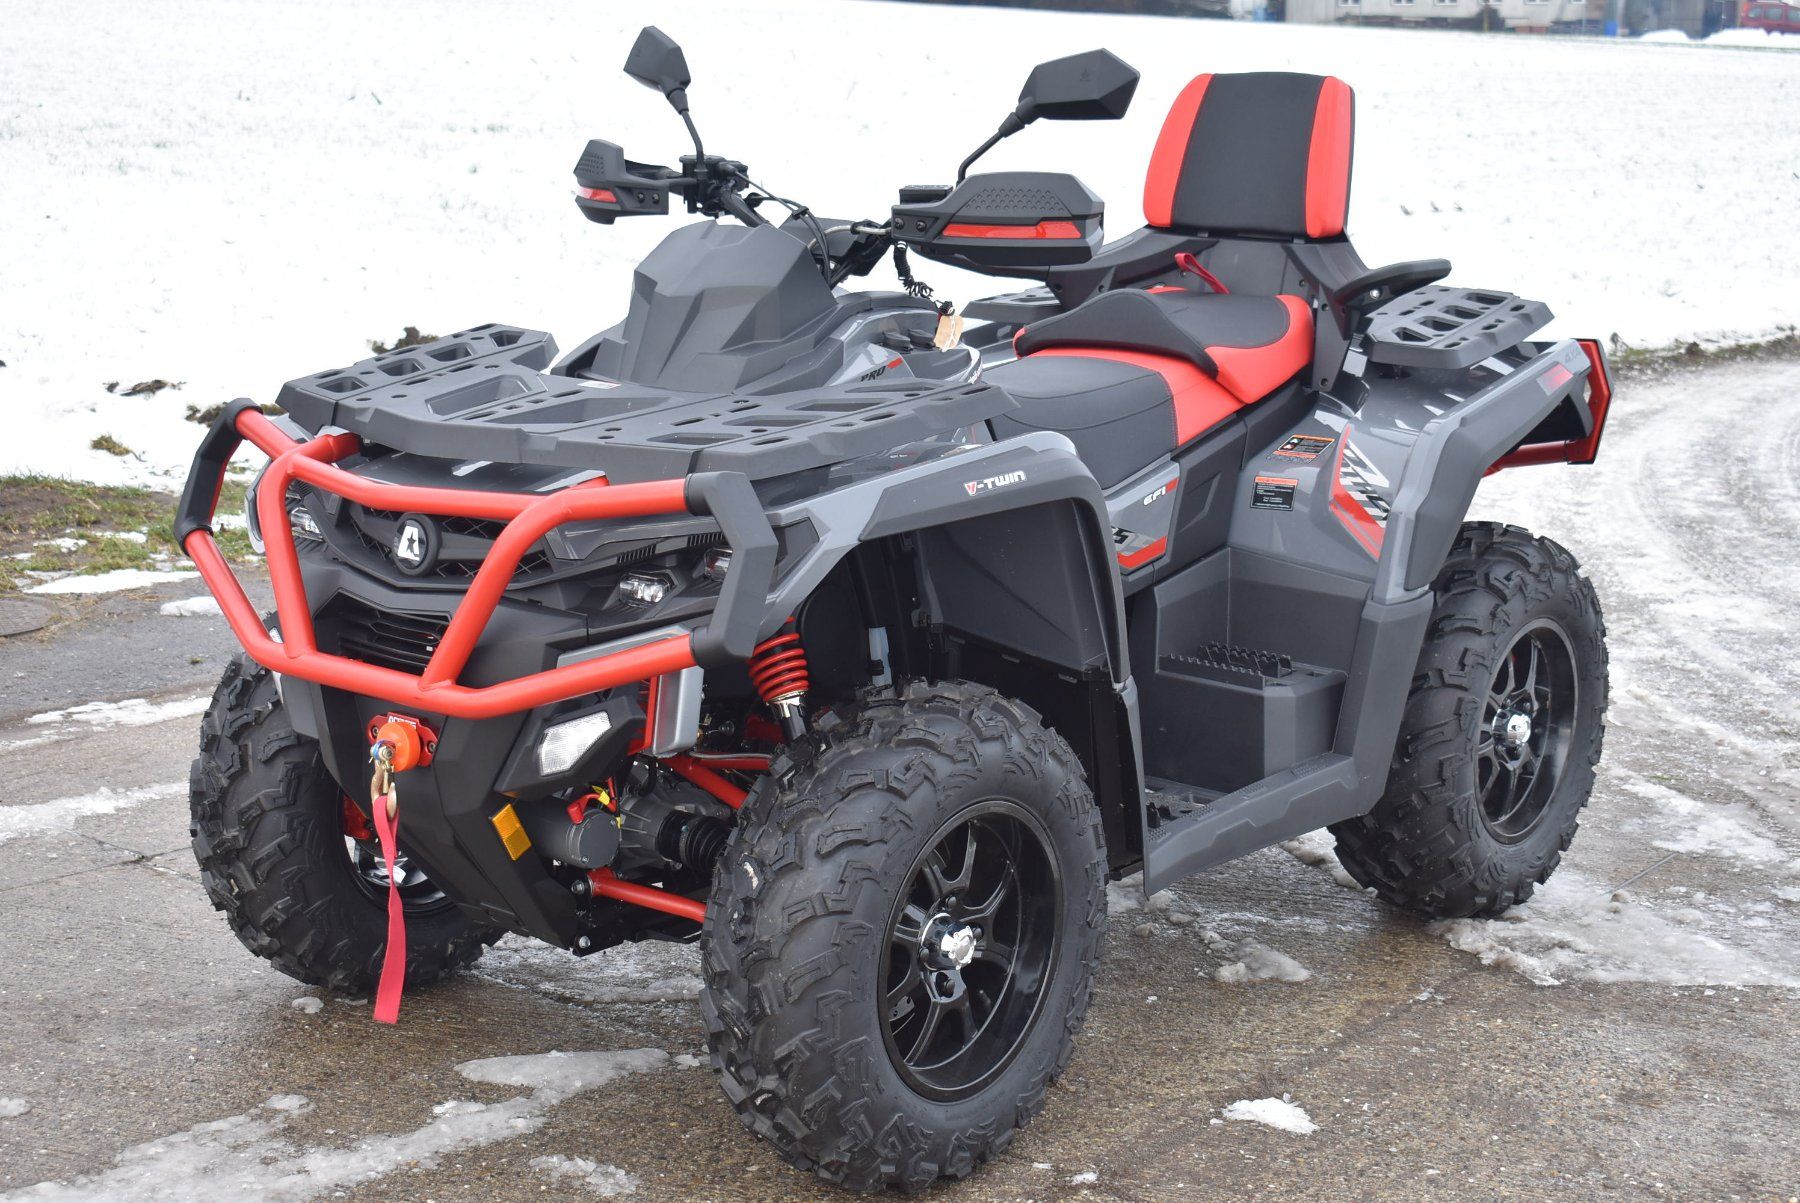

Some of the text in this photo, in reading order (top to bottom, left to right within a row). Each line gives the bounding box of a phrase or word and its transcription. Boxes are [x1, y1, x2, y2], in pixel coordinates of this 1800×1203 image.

[860, 365, 886, 382] PRO
[964, 470, 1026, 496] V-TWIN
[1143, 486, 1166, 506] EFI
